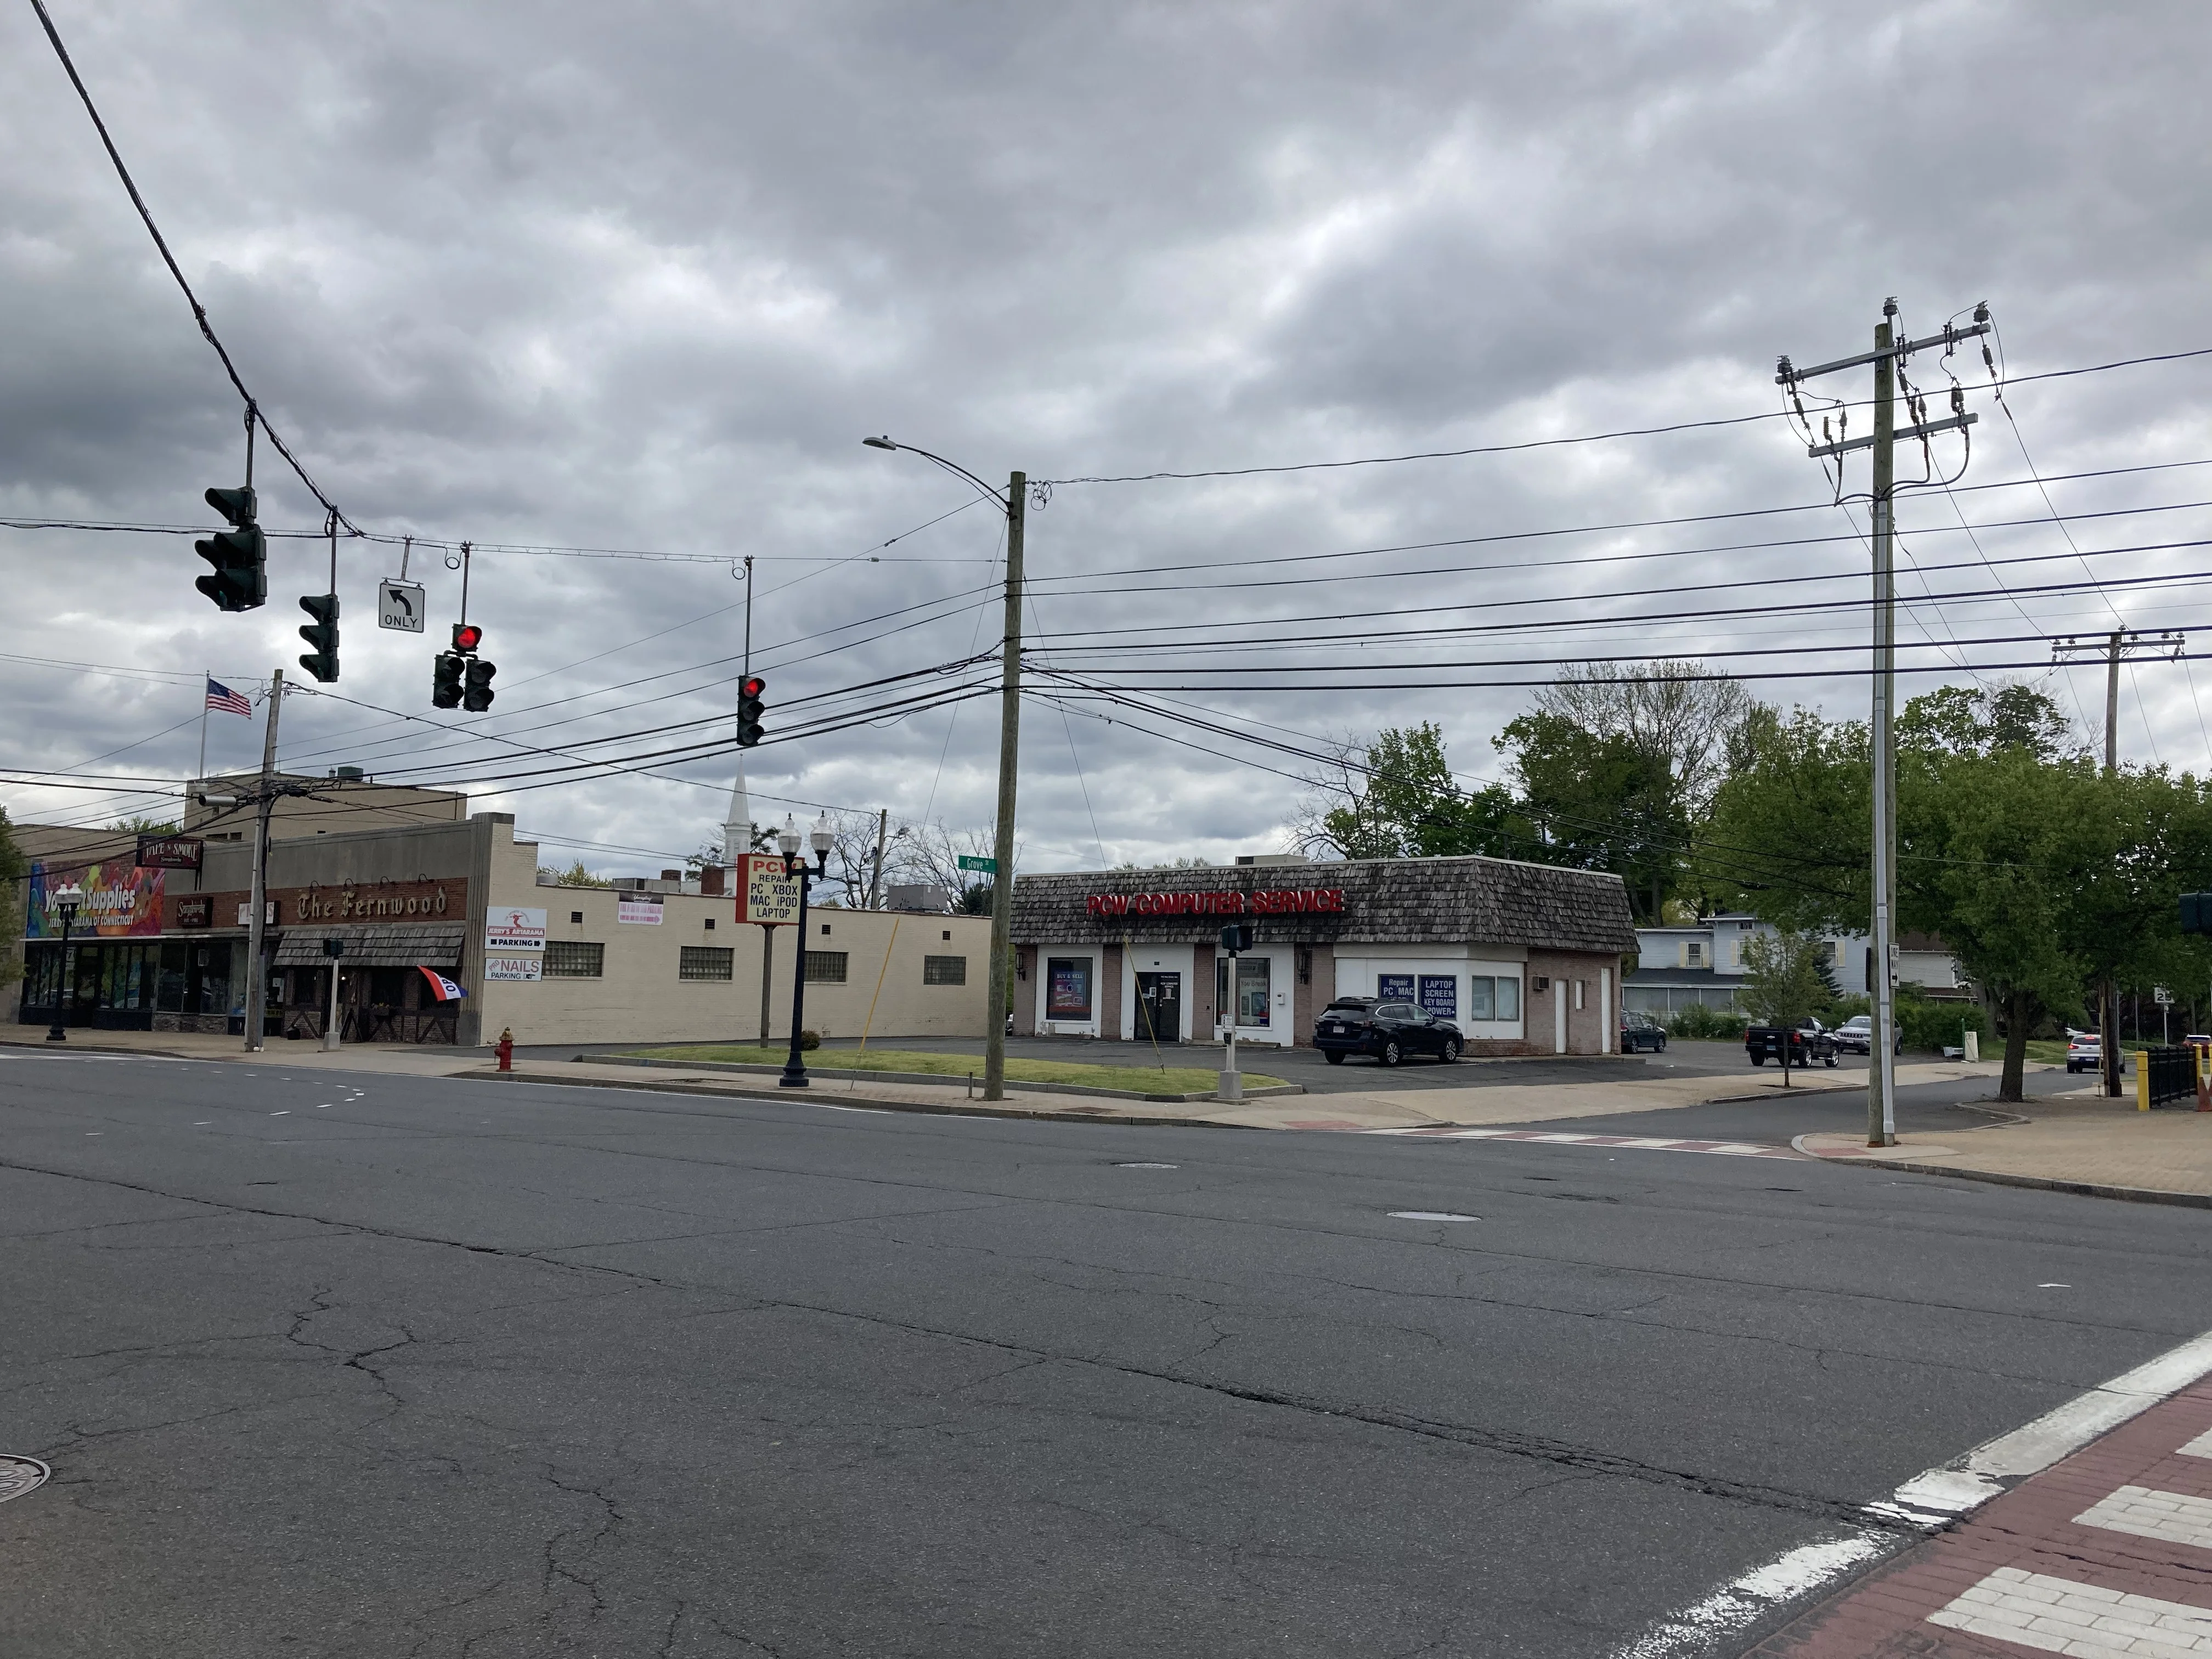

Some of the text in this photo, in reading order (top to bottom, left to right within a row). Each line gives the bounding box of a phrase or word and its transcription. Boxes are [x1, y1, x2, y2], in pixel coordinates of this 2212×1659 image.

[385, 614, 418, 628] ONLY
[173, 843, 198, 861] SMOKE
[967, 857, 983, 869] Grove
[751, 883, 798, 896] PC XBOX
[297, 893, 334, 919] The
[340, 886, 448, 917] Fernwood
[750, 895, 798, 907] MAC iPOD
[1087, 890, 1346, 915] PCW COMPUTER SERVICE
[757, 907, 791, 919] LAPTOP
[101, 914, 134, 927] CONNECTICUT
[488, 960, 539, 973] PRO NAILS
[1389, 978, 1409, 987] Repair
[1425, 980, 1453, 989] LAPTOP
[1383, 987, 1414, 996] PC MAC
[1425, 989, 1454, 997] SCREEN
[2157, 993, 2172, 1001] 25
[1424, 998, 1435, 1006] KEY
